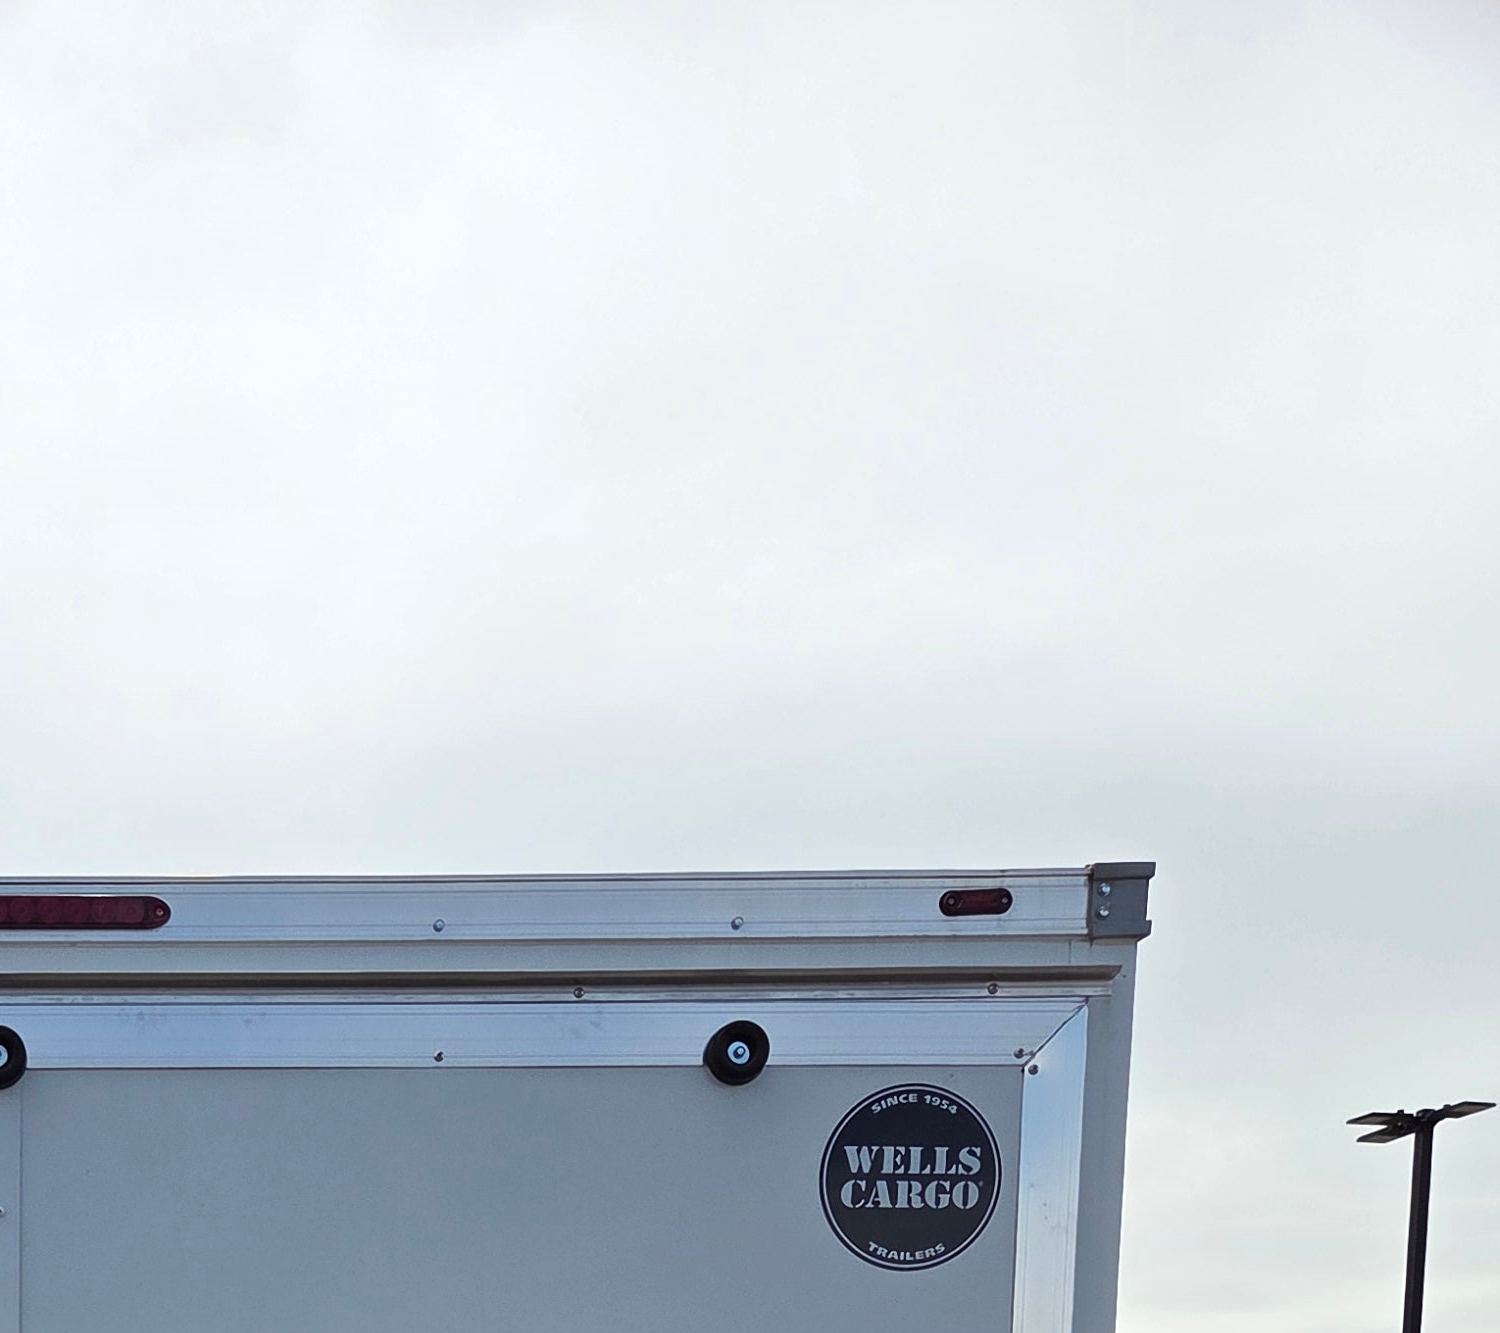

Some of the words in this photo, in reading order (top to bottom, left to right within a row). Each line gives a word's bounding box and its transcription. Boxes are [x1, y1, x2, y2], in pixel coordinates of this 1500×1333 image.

[870, 1093, 918, 1114] SINCE
[924, 1095, 959, 1114] 1954
[843, 1145, 982, 1176] WELLS
[840, 1179, 980, 1210] CARGO
[868, 1241, 946, 1261] TRAILERS
